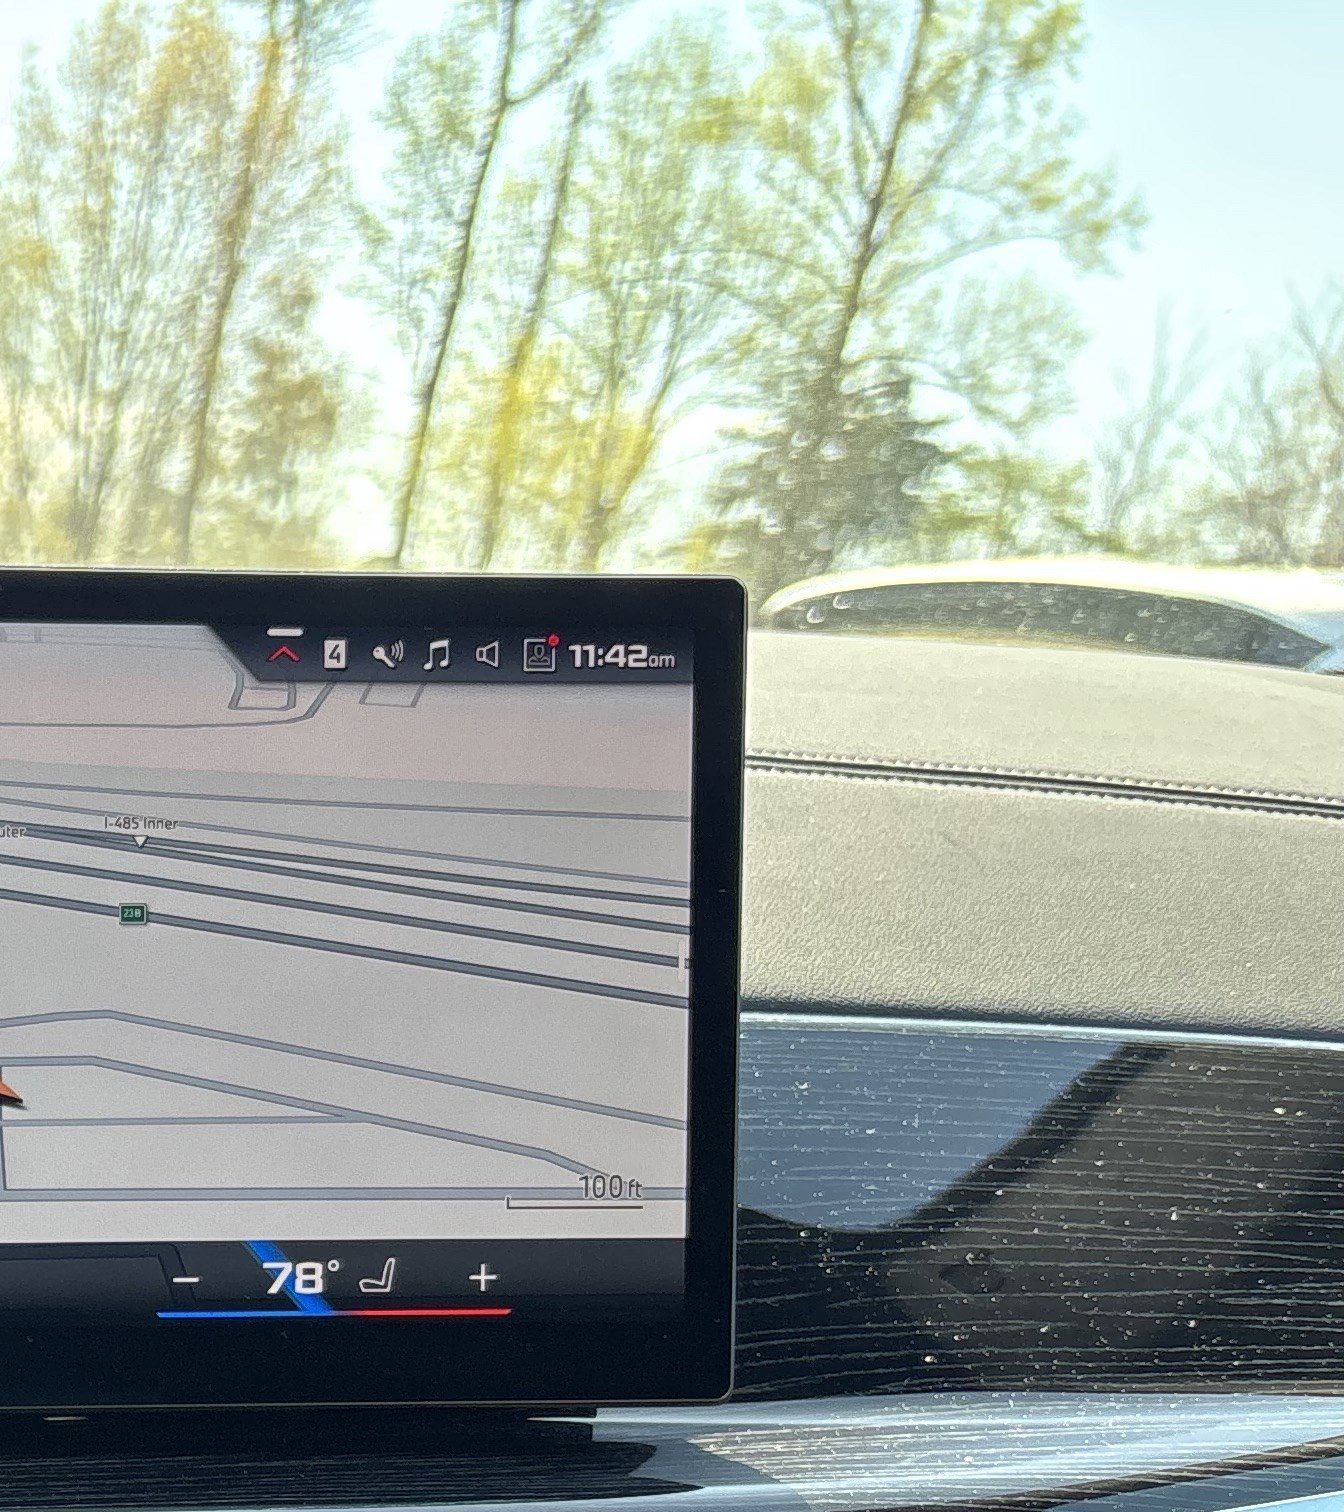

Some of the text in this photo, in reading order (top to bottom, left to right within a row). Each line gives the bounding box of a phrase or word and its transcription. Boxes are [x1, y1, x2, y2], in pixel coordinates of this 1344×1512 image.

[104, 816, 179, 831] I-485 Inner
[578, 1175, 644, 1199] 100 ft
